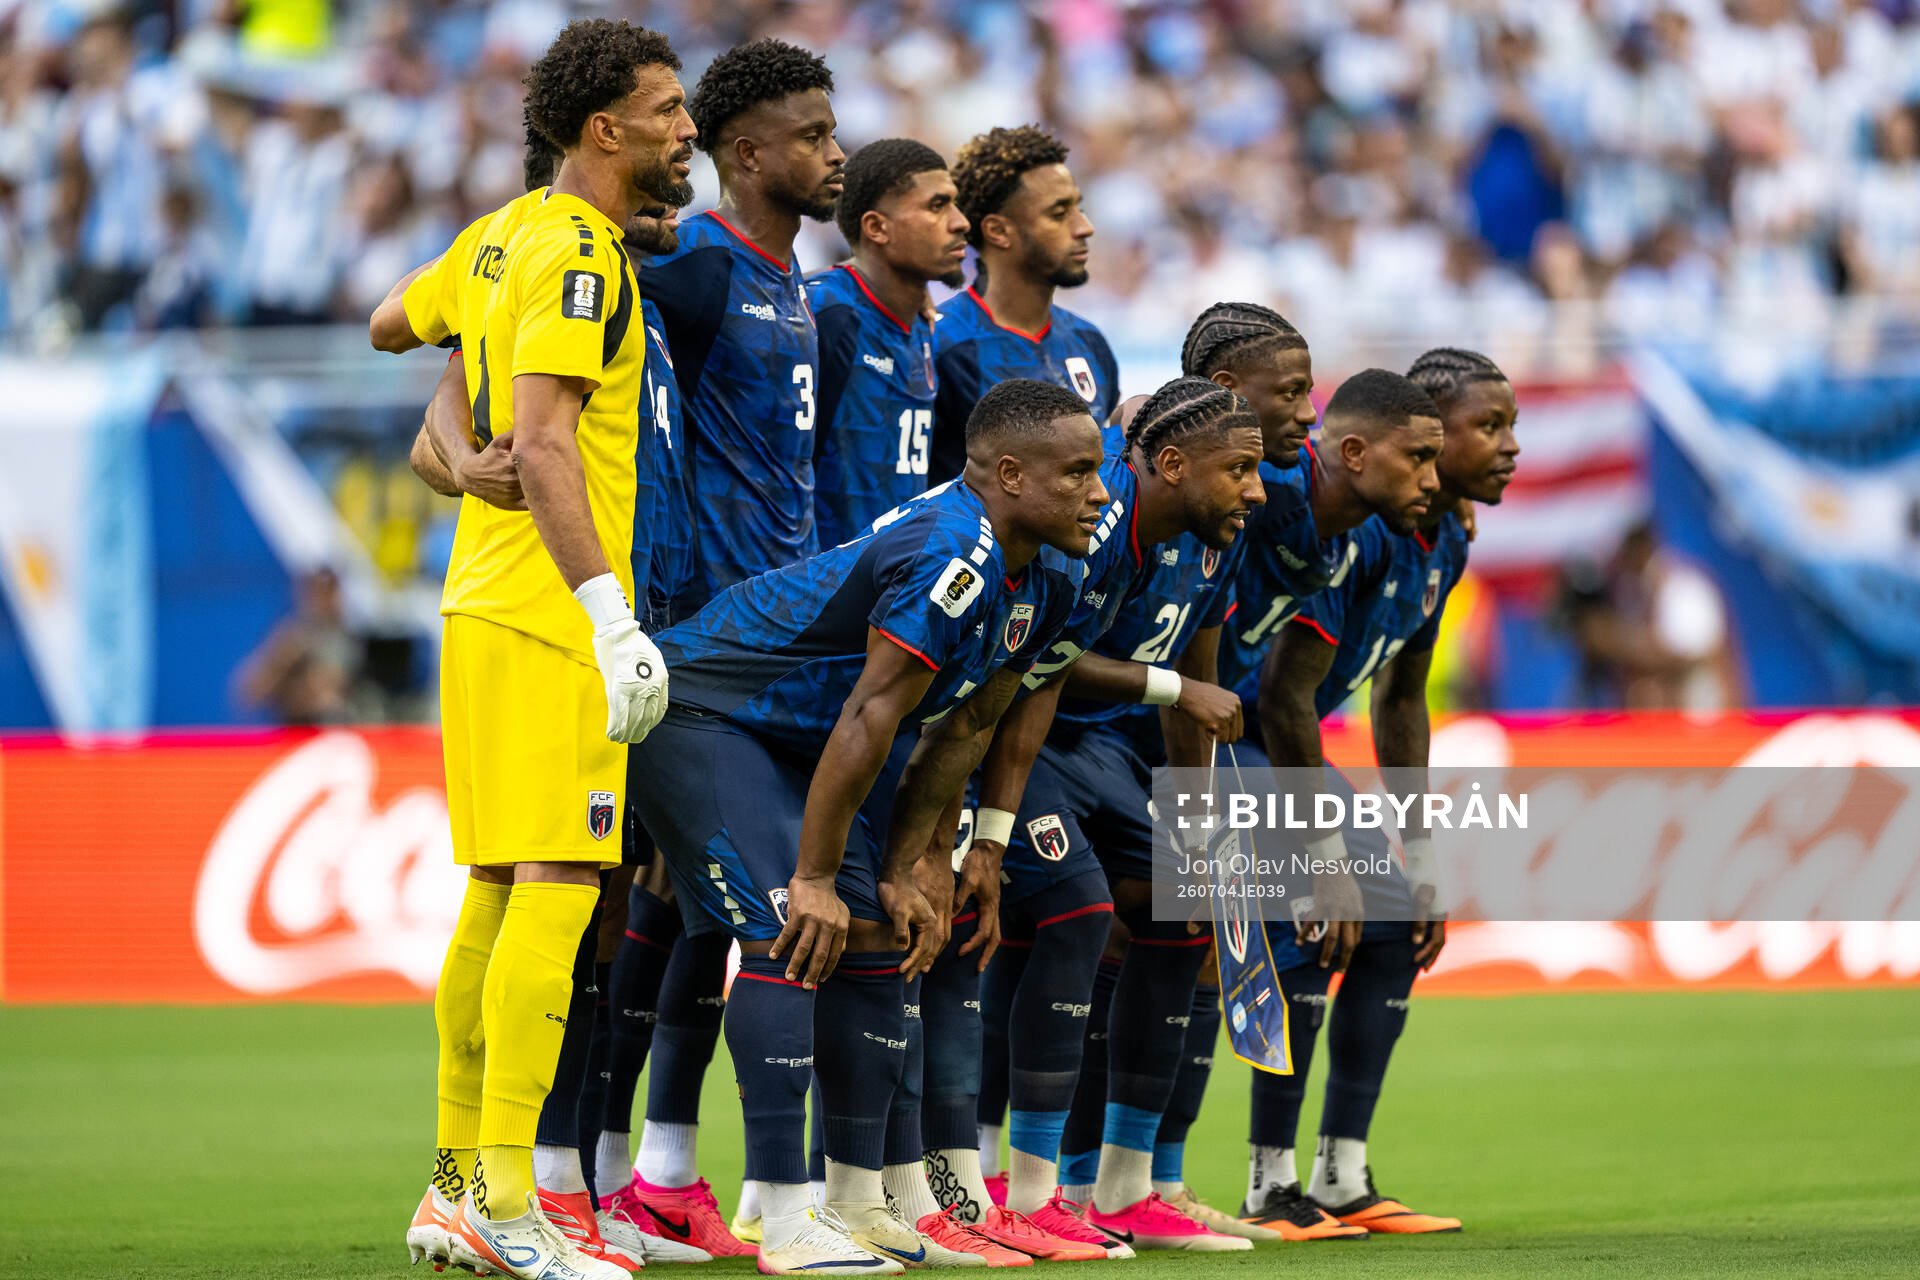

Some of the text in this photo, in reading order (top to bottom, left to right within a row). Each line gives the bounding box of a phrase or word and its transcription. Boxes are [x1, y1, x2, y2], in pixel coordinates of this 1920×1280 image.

[792, 364, 816, 431] 3
[896, 408, 932, 475] 15
[1130, 602, 1192, 664] 21
[590, 792, 614, 801] FCF
[1031, 816, 1057, 831] FCF
